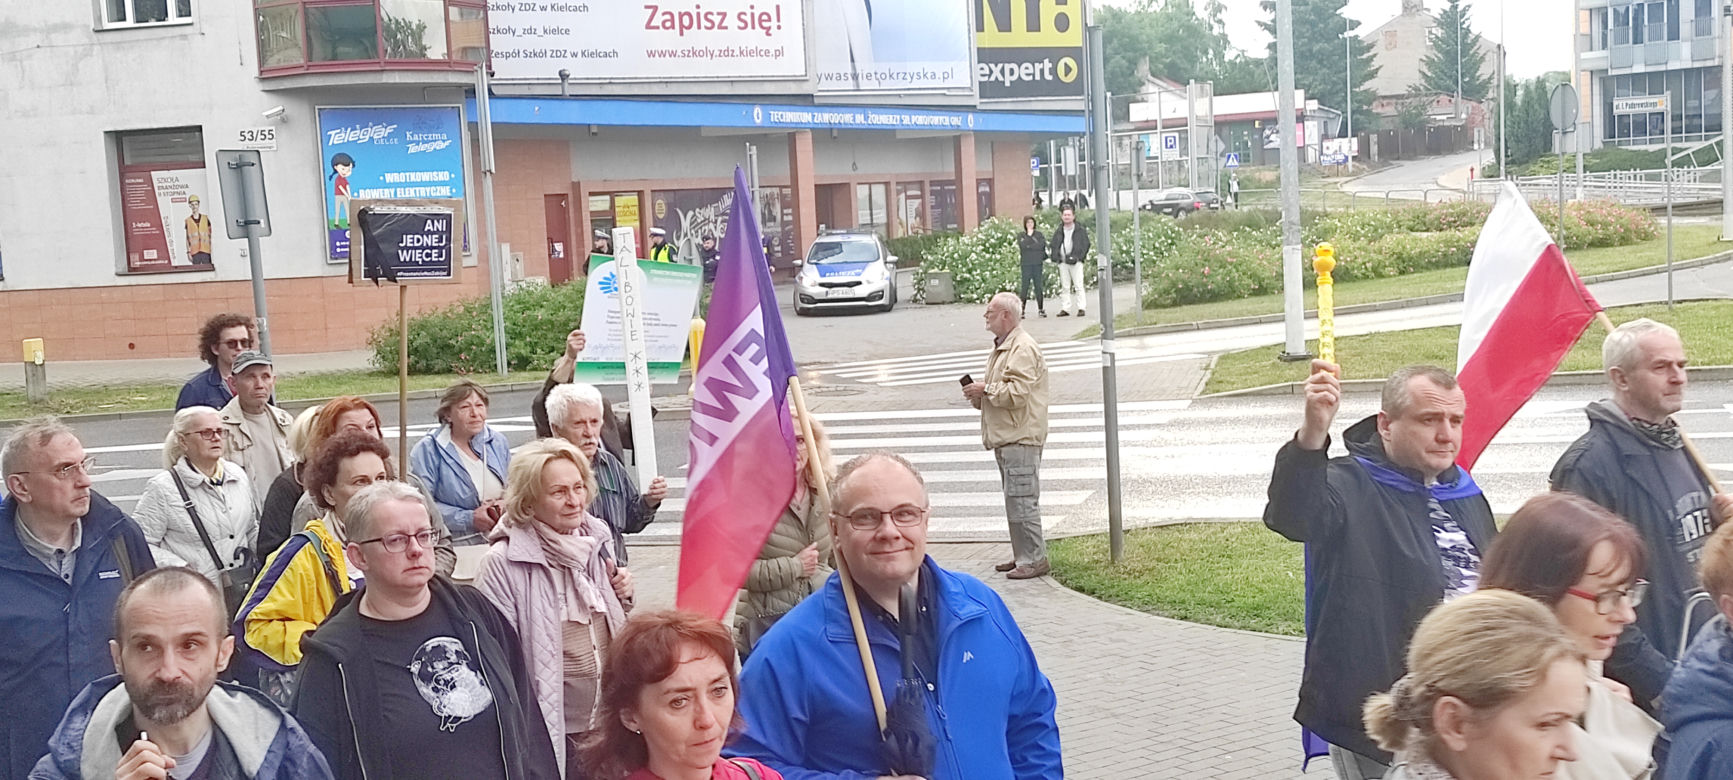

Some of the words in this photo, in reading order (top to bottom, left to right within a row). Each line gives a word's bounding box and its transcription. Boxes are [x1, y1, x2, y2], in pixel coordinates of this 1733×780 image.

[486, 1, 516, 14] Szkoły
[518, 2, 537, 12] ZDZ
[539, 4, 548, 12] w
[550, 2, 589, 13] Kielcach
[644, 4, 729, 37] Zapisz
[736, 4, 782, 37] się!
[490, 48, 520, 61] Zespół
[522, 48, 548, 59] Szkół
[549, 49, 568, 59] ZDZ
[570, 51, 579, 59] w
[581, 49, 619, 59] Kielcach
[646, 45, 785, 60] www.szkoly.zdz.kielce.pl
[976, 58, 1053, 87] expert
[769, 110, 813, 124] TECHNIKUM
[814, 112, 854, 125] ZAWODOWE
[239, 129, 275, 142] 53/55
[327, 123, 398, 146] Telegraf
[406, 131, 448, 142] Karczma
[406, 140, 452, 154] Telegraf
[385, 171, 450, 184] WROTKOWISKO
[359, 188, 395, 200] ROWERY
[396, 186, 451, 199] ELEKTRYCZNE
[424, 218, 447, 232] ANI
[399, 234, 446, 247] JEDNEJ
[398, 249, 446, 264] WIĘCEJ
[618, 232, 638, 342] TALIBOWIE
